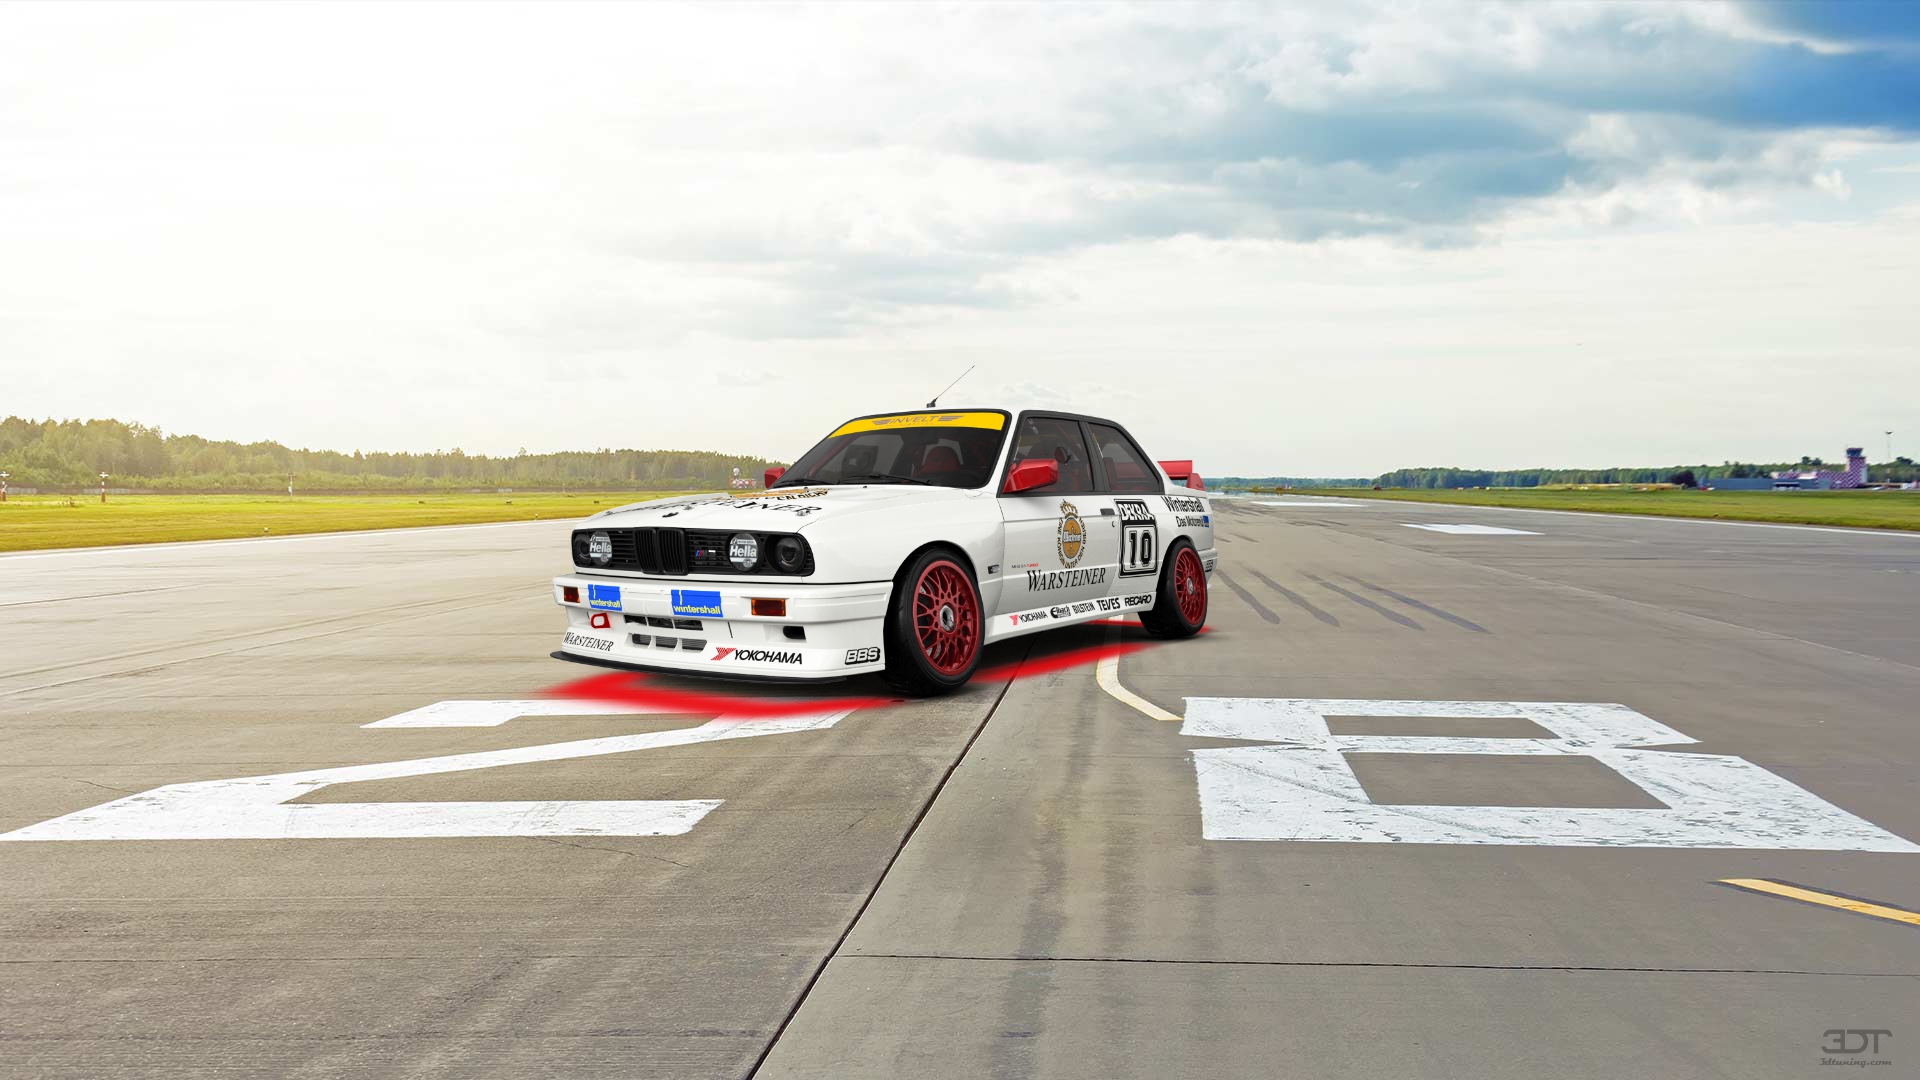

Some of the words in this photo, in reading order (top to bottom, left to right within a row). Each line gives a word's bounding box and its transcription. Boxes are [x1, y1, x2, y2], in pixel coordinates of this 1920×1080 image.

[890, 415, 938, 425] INVELT
[1117, 503, 1155, 520] DEKRA
[590, 541, 612, 553] Hella
[730, 545, 757, 557] Hella
[1129, 530, 1152, 568] 10
[1027, 567, 1106, 592] WARSTEINER
[590, 600, 621, 608] wintershall
[673, 605, 720, 614] wintershall
[1019, 611, 1048, 623] YOKOHAMA
[1072, 602, 1096, 614] BILSTEIN
[1096, 597, 1121, 611] TEVES
[1124, 594, 1152, 607] RECARO
[563, 631, 614, 651] WARSTEINER
[734, 649, 803, 665] YOKOHAMA
[845, 647, 881, 665] BBS
